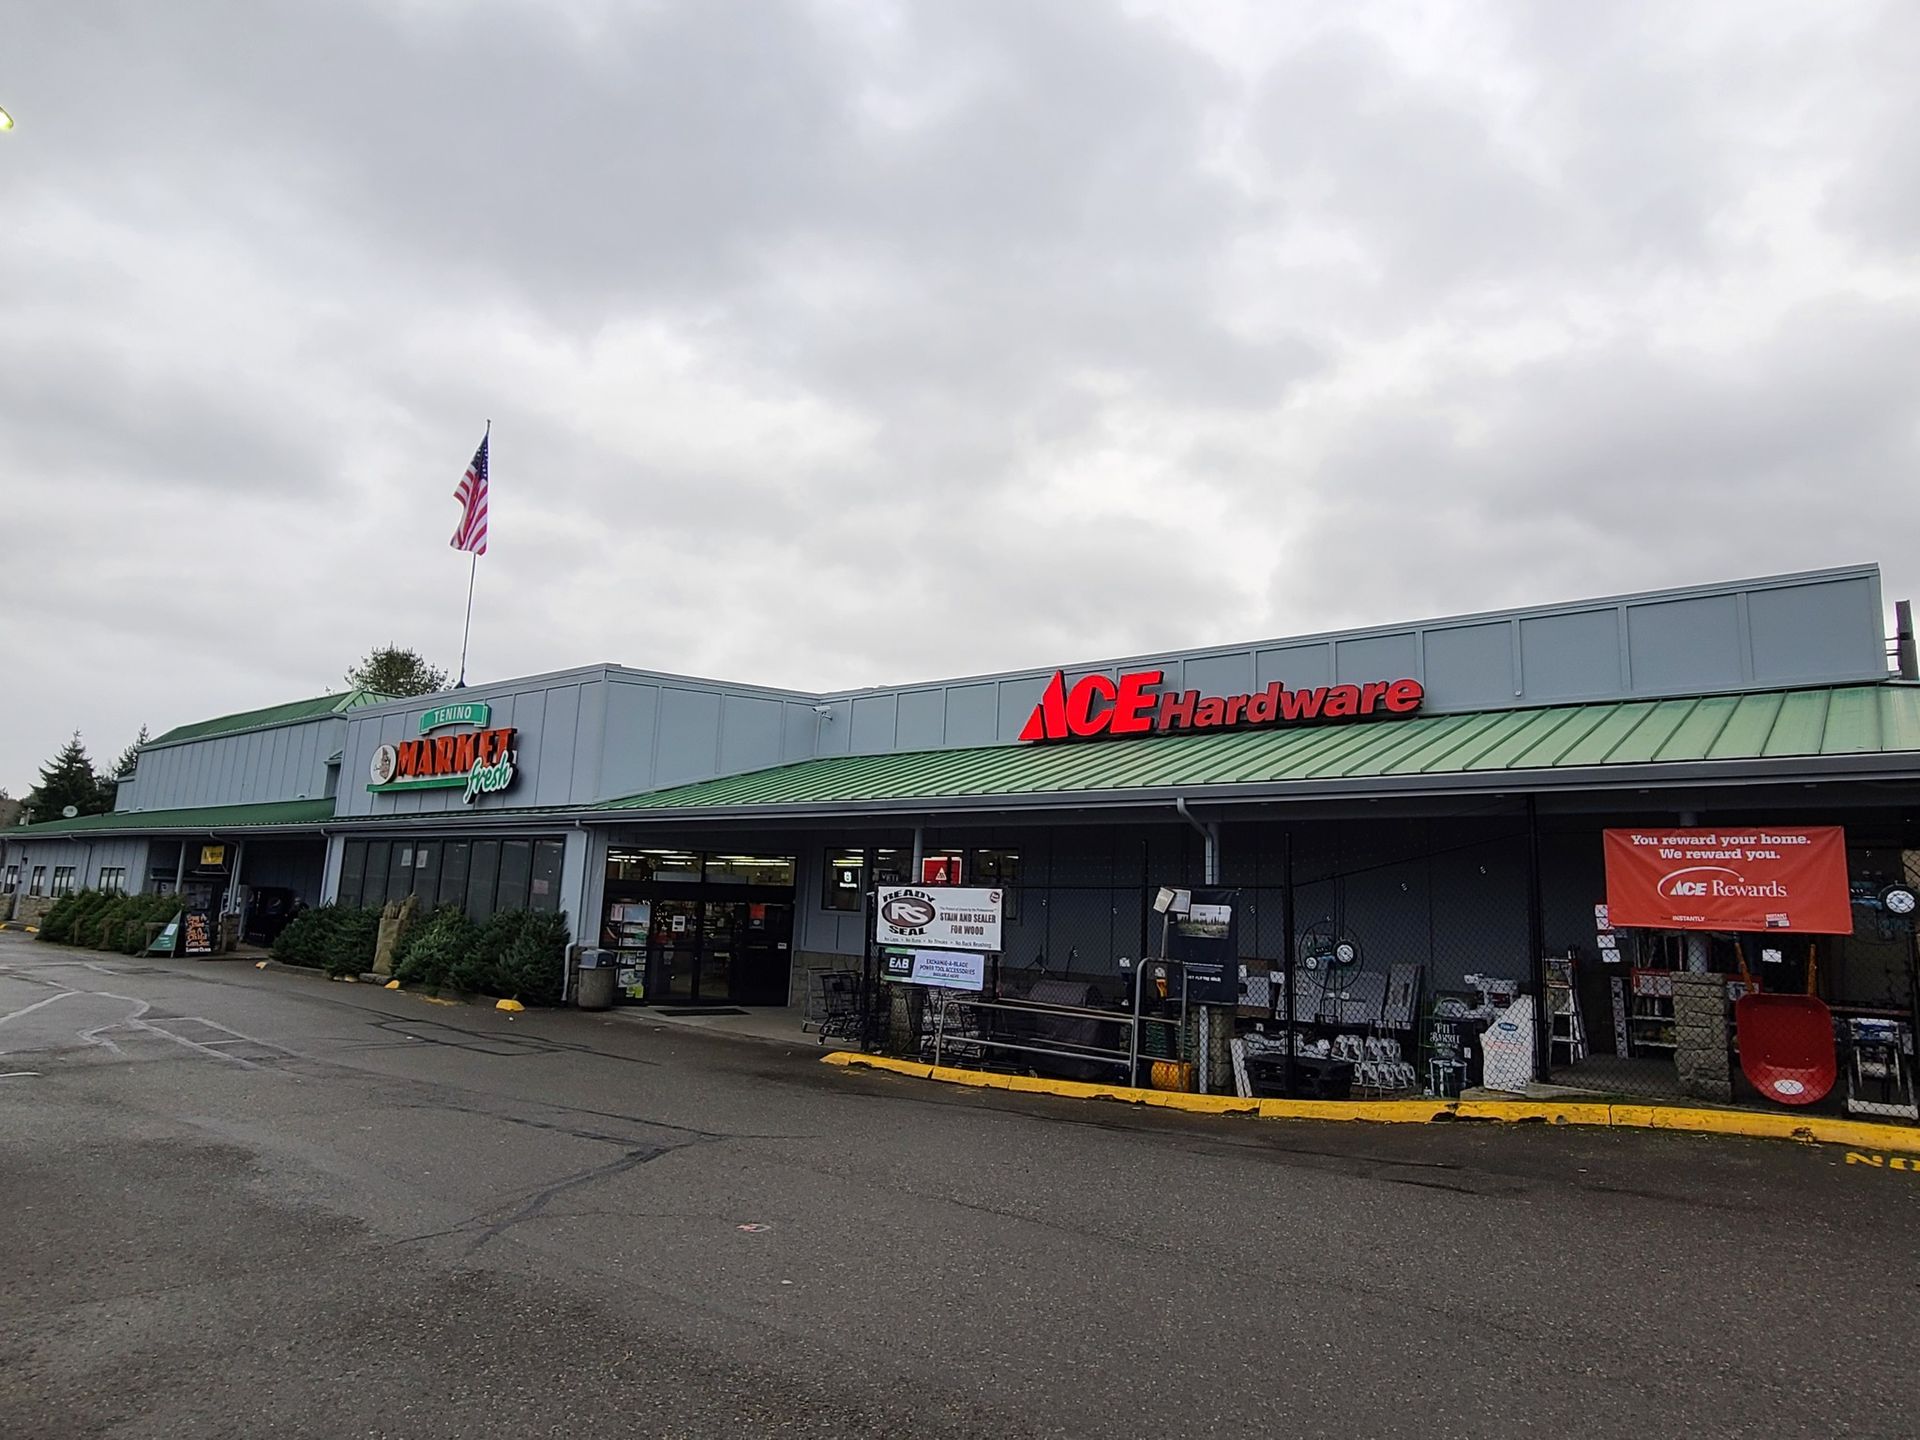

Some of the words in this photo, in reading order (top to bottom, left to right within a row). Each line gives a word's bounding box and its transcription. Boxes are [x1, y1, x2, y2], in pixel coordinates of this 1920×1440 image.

[1018, 669, 1163, 742] ACE
[1158, 677, 1424, 732] Hardware
[434, 706, 472, 724] TENINO
[397, 728, 516, 777] MARKET
[463, 750, 514, 804] fresh
[1631, 835, 1658, 846] You
[1662, 835, 1716, 846] reward
[1720, 836, 1757, 847] your
[1760, 834, 1811, 845] home.
[1659, 849, 1683, 859] We
[1685, 849, 1742, 860] reward
[1746, 850, 1781, 862] you.
[1669, 880, 1707, 896] ACE
[1712, 879, 1787, 897] Rewards
[882, 889, 937, 903] READY
[891, 902, 930, 924] RS
[940, 912, 958, 922] STAIN
[959, 913, 972, 922] AND
[973, 913, 996, 924] SEALER
[1672, 915, 1706, 923] INSTANTLY
[889, 925, 928, 936] SEAL
[950, 925, 962, 934] FOR
[964, 926, 984, 935] WOOD
[889, 957, 909, 969] EAB
[945, 966, 976, 975] ACCESSORIES
